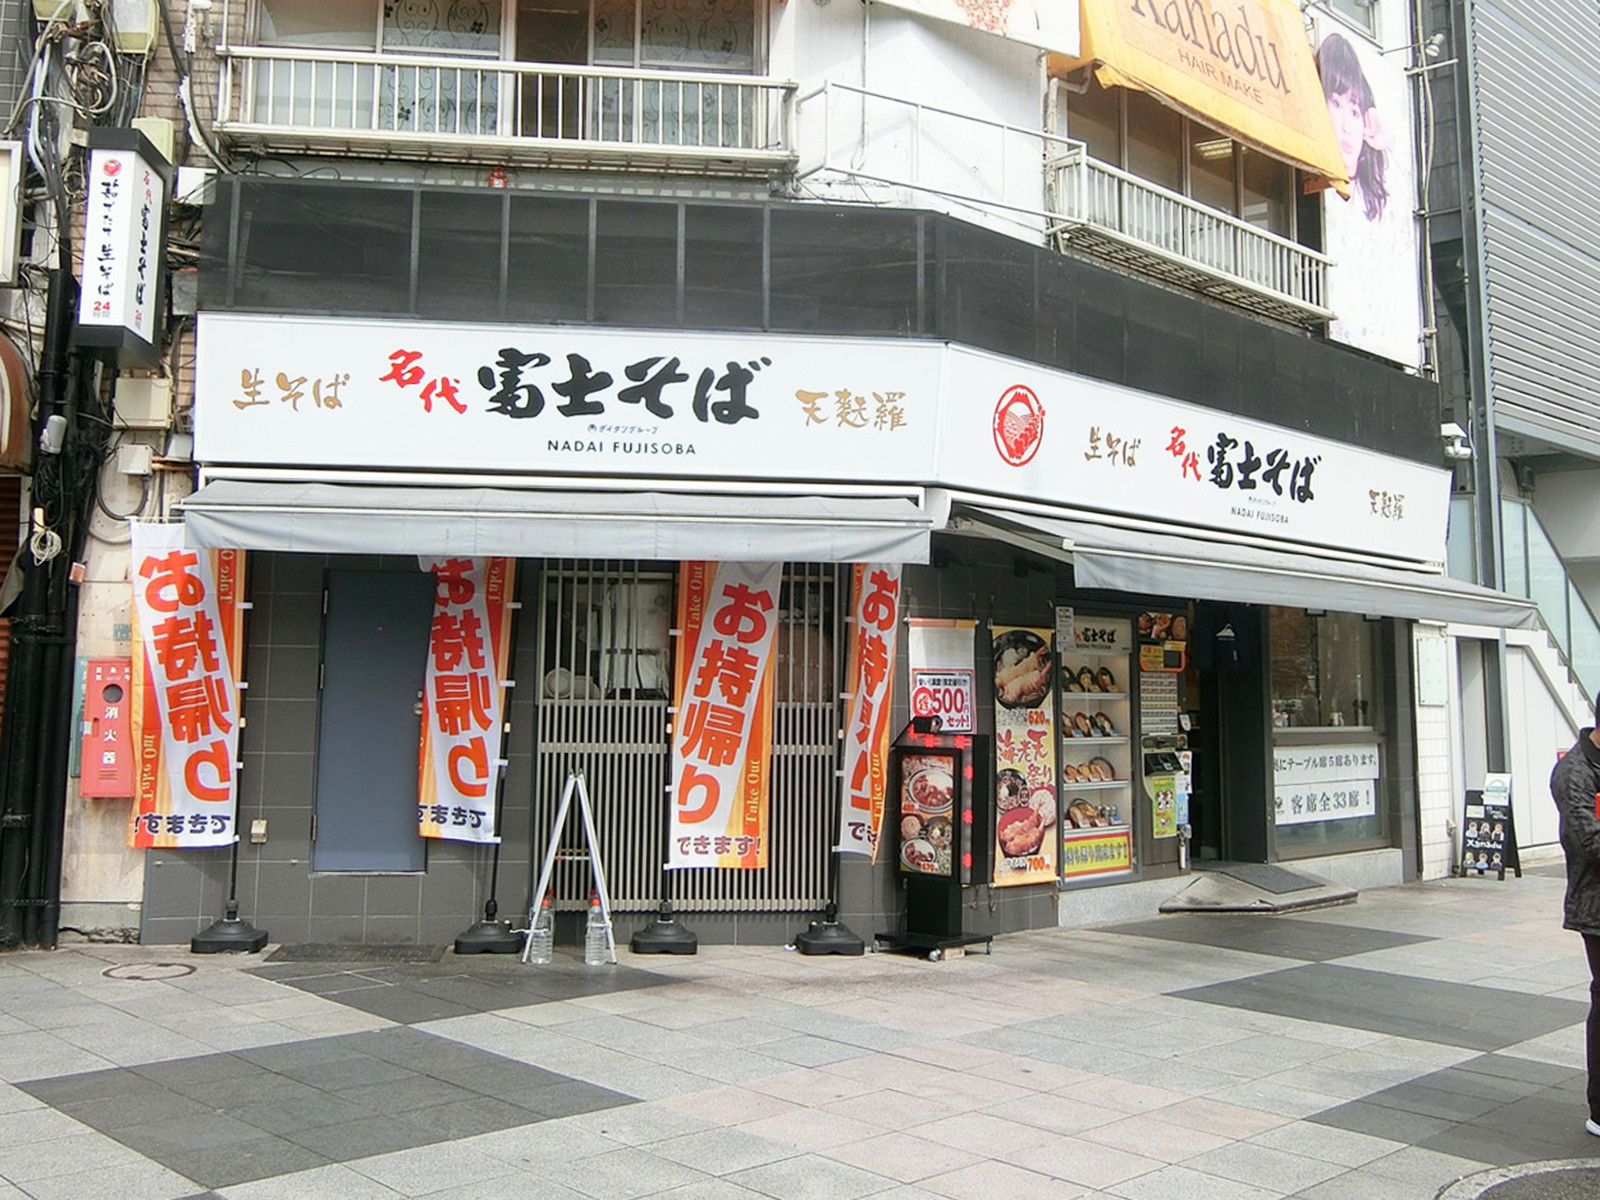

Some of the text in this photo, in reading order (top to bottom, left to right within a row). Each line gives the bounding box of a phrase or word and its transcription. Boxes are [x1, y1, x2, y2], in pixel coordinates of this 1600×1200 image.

[1178, 48, 1264, 105] HAIR MAKE
[93, 301, 111, 311] 24
[232, 368, 350, 412] 生そば
[379, 348, 468, 414] 名代
[477, 347, 772, 425] 富士そば
[547, 439, 697, 455] NADAI FUJISOBA
[1084, 426, 1141, 467] 生そば
[1165, 426, 1202, 481] 名代
[1207, 432, 1321, 503] 富士そば
[1231, 506, 1289, 524] NADAI FUJISOBA
[687, 595, 702, 632] Take
[678, 583, 775, 824] お持帰り
[103, 706, 119, 765] 消火器
[745, 759, 761, 824] Take Out
[677, 835, 761, 855] できます!
[1467, 839, 1502, 849] Xanadu
